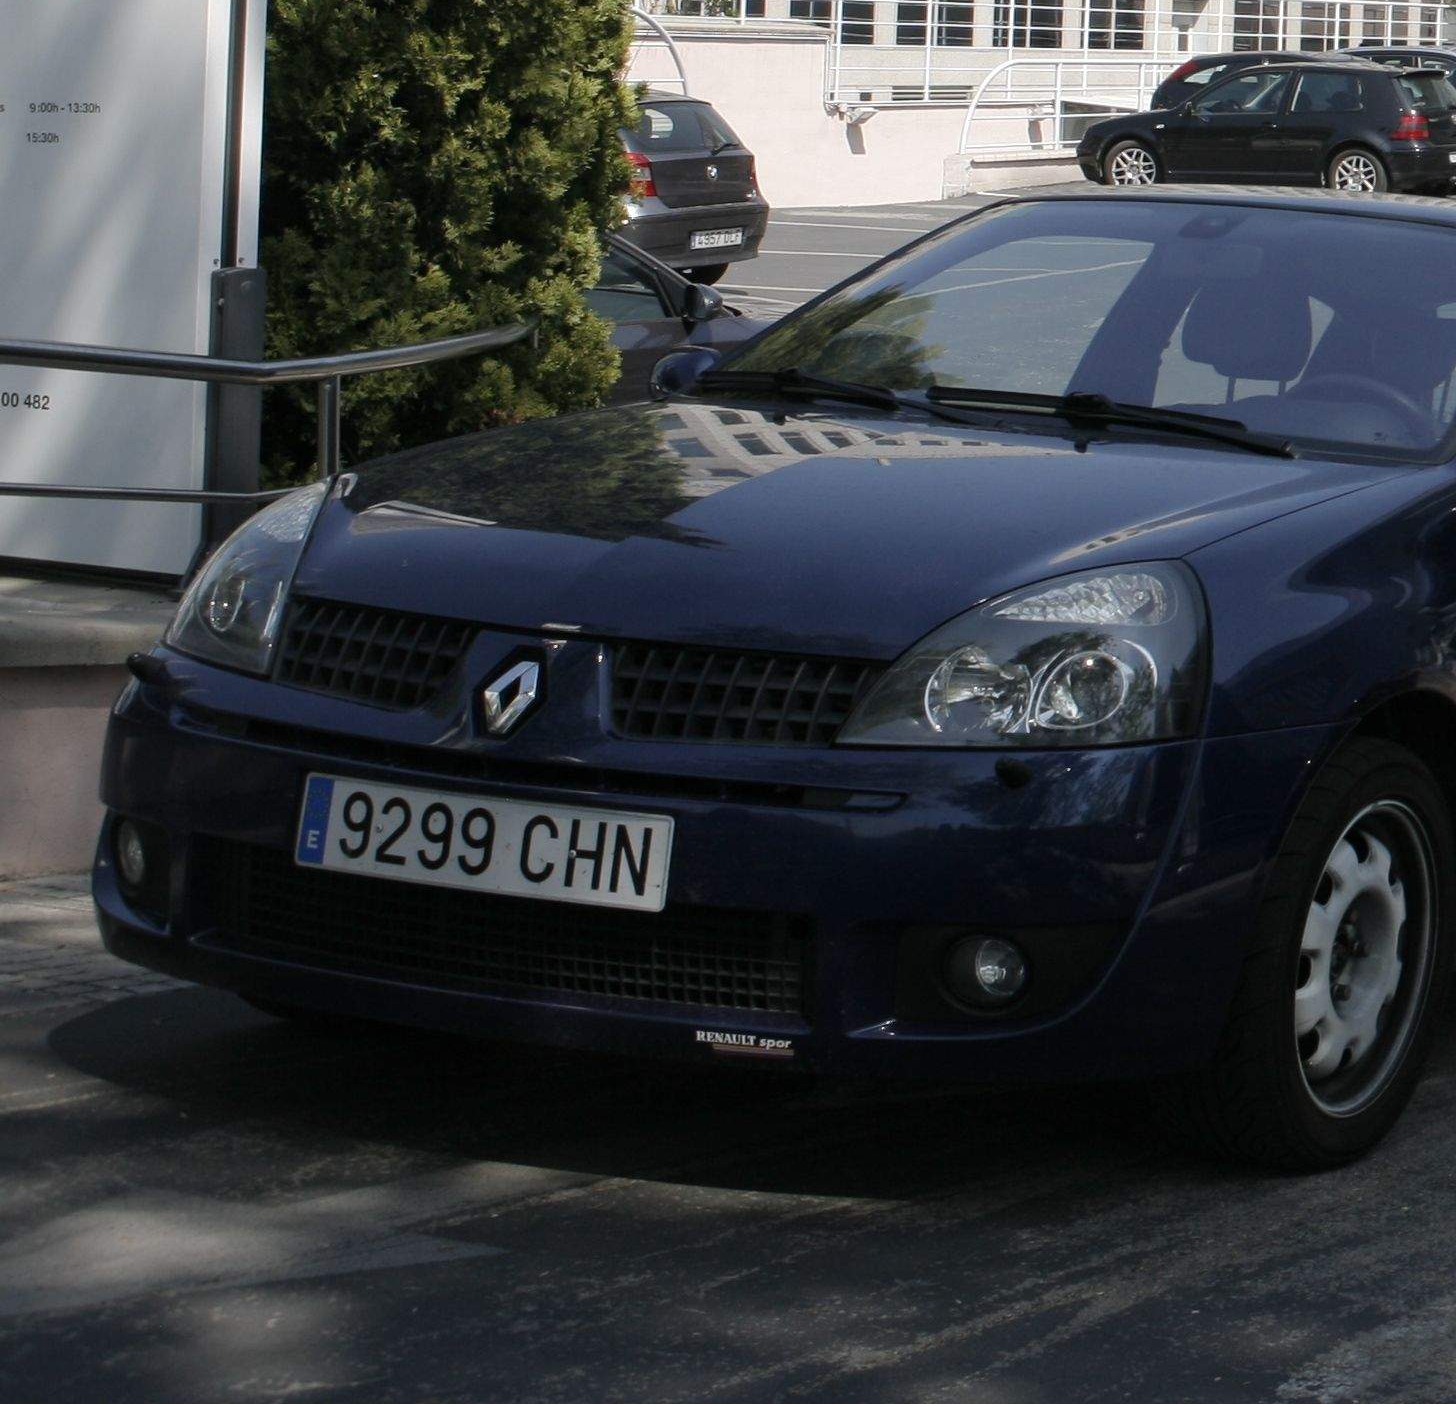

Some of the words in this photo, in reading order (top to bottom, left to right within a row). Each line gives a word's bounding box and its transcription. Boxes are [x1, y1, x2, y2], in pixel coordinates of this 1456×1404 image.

[68, 102, 101, 113] 13:30h
[24, 394, 50, 410] 482
[308, 830, 319, 849] E
[338, 791, 496, 876] 9299
[519, 814, 653, 896] CHN
[696, 1030, 756, 1046] RENAULT
